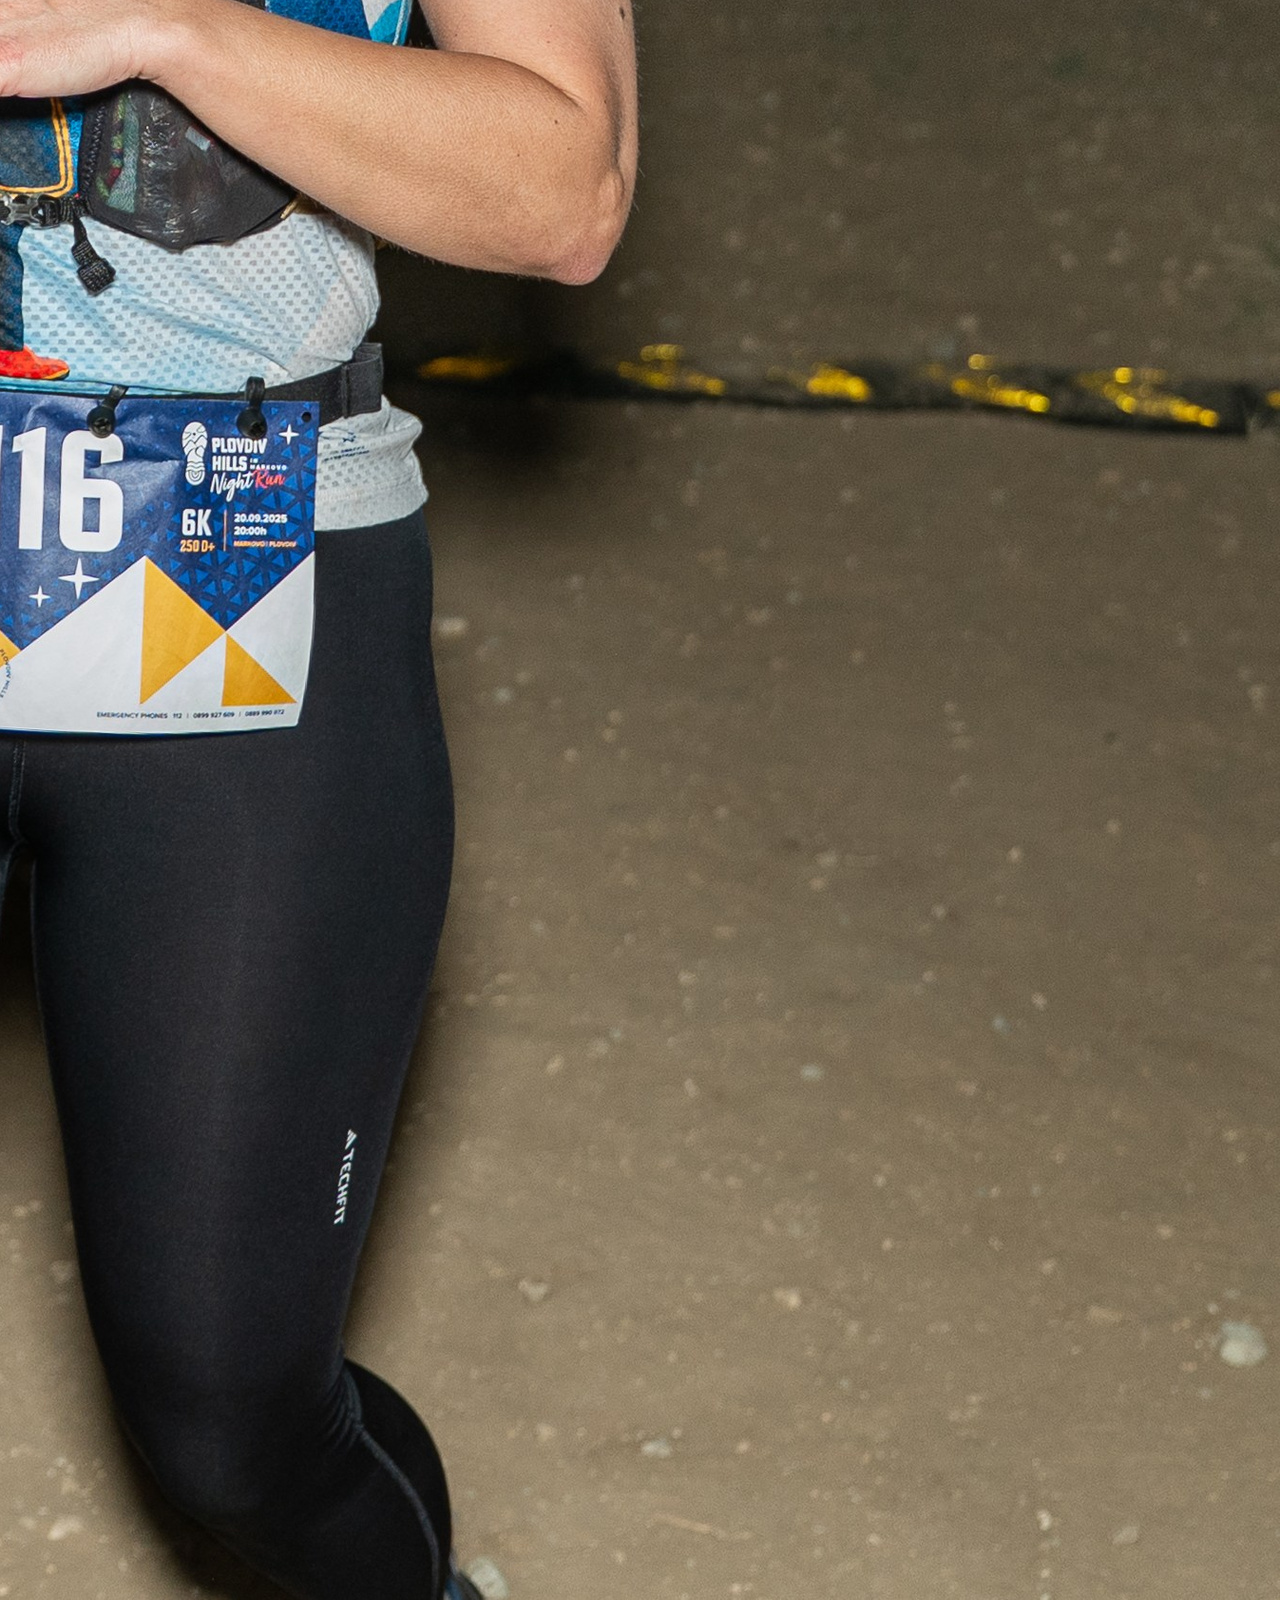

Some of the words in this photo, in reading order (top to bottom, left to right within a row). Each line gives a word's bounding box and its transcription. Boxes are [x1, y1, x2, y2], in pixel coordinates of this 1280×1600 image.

[211, 437, 268, 454] PLOVDIV
[212, 455, 248, 472] HILLS
[210, 471, 255, 502] Night
[252, 468, 286, 489] Run
[181, 508, 213, 537] 6K
[233, 513, 288, 524] 20.09.2025
[233, 526, 268, 536] 20:00h
[180, 539, 200, 553] 250
[200, 539, 216, 553] D+
[96, 711, 139, 719] EMERGENCY
[333, 1147, 355, 1225] TECHFIT
